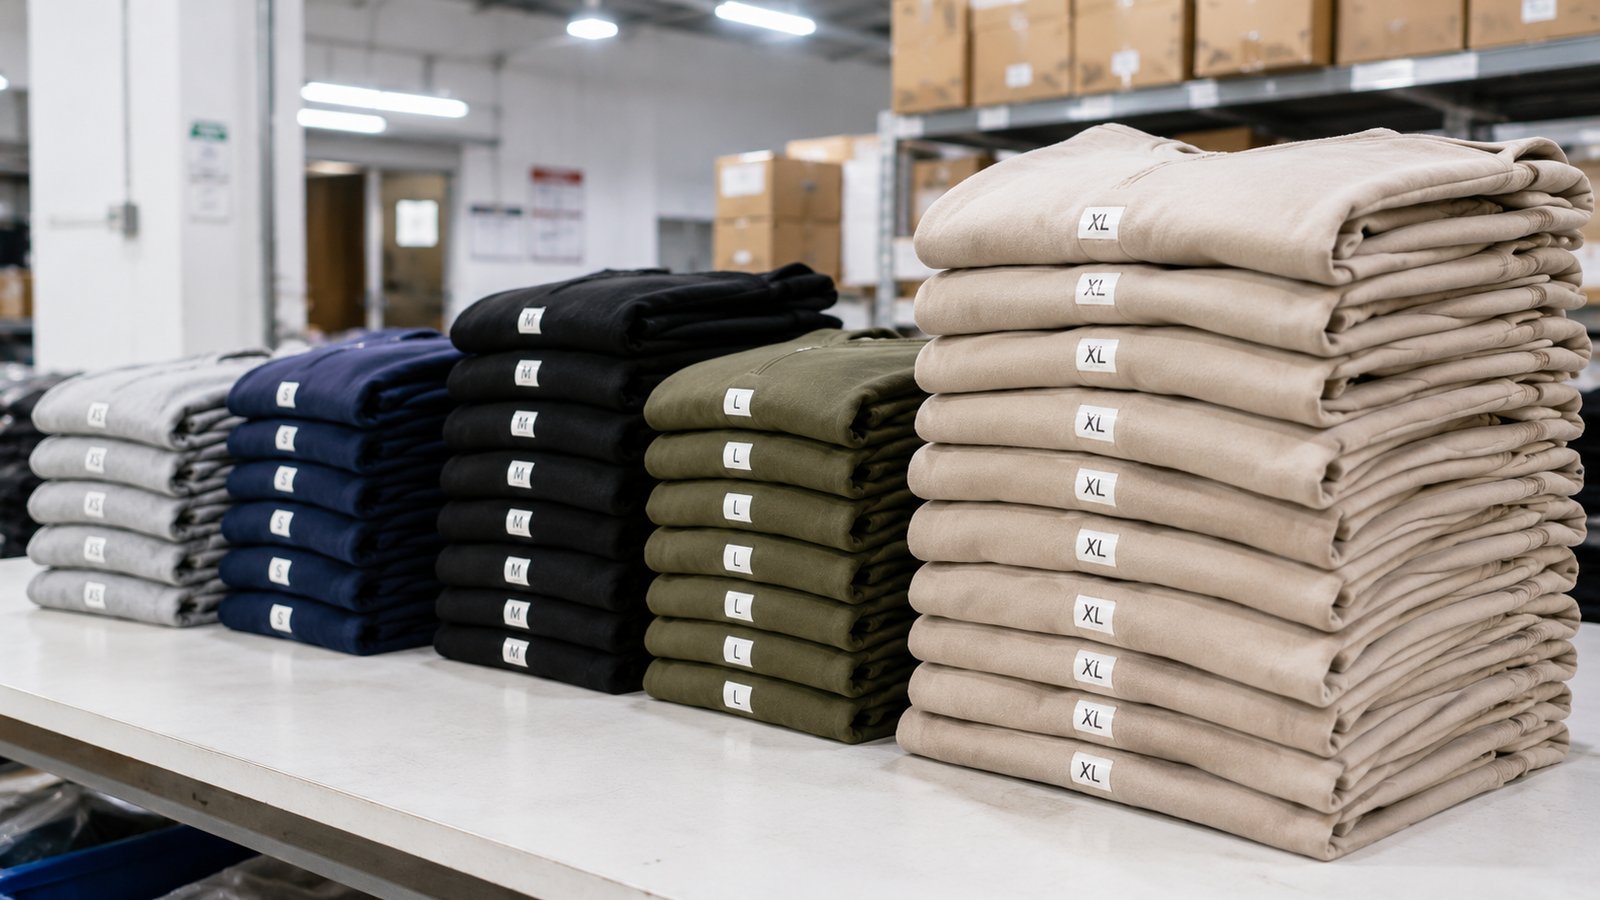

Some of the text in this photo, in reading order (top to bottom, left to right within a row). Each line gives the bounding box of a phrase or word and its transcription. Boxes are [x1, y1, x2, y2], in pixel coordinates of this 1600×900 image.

[1088, 214, 1109, 230] XL
[1084, 279, 1105, 296] XL
[524, 314, 535, 326] M
[1085, 345, 1106, 363] XL
[521, 366, 531, 379] M
[282, 389, 290, 401] S
[733, 395, 741, 409] L
[518, 417, 528, 429] M
[1084, 413, 1105, 433] XL
[282, 432, 289, 444] S
[732, 449, 740, 463] L
[280, 472, 289, 486] S
[514, 467, 524, 480] M
[1084, 476, 1105, 497] XL
[733, 500, 741, 515] L
[276, 516, 284, 530] S
[513, 516, 523, 528] M
[1085, 538, 1106, 557] XL
[733, 552, 741, 567] L
[275, 564, 282, 579] S
[511, 564, 521, 577] M
[511, 606, 520, 620] M
[734, 599, 742, 614] L
[277, 612, 284, 625] S
[1083, 604, 1103, 624] XL
[509, 645, 519, 659] M
[733, 645, 741, 659] L
[1082, 659, 1102, 679] XL
[733, 690, 741, 705] L
[1082, 709, 1102, 729] XL
[1080, 762, 1100, 783] XL
